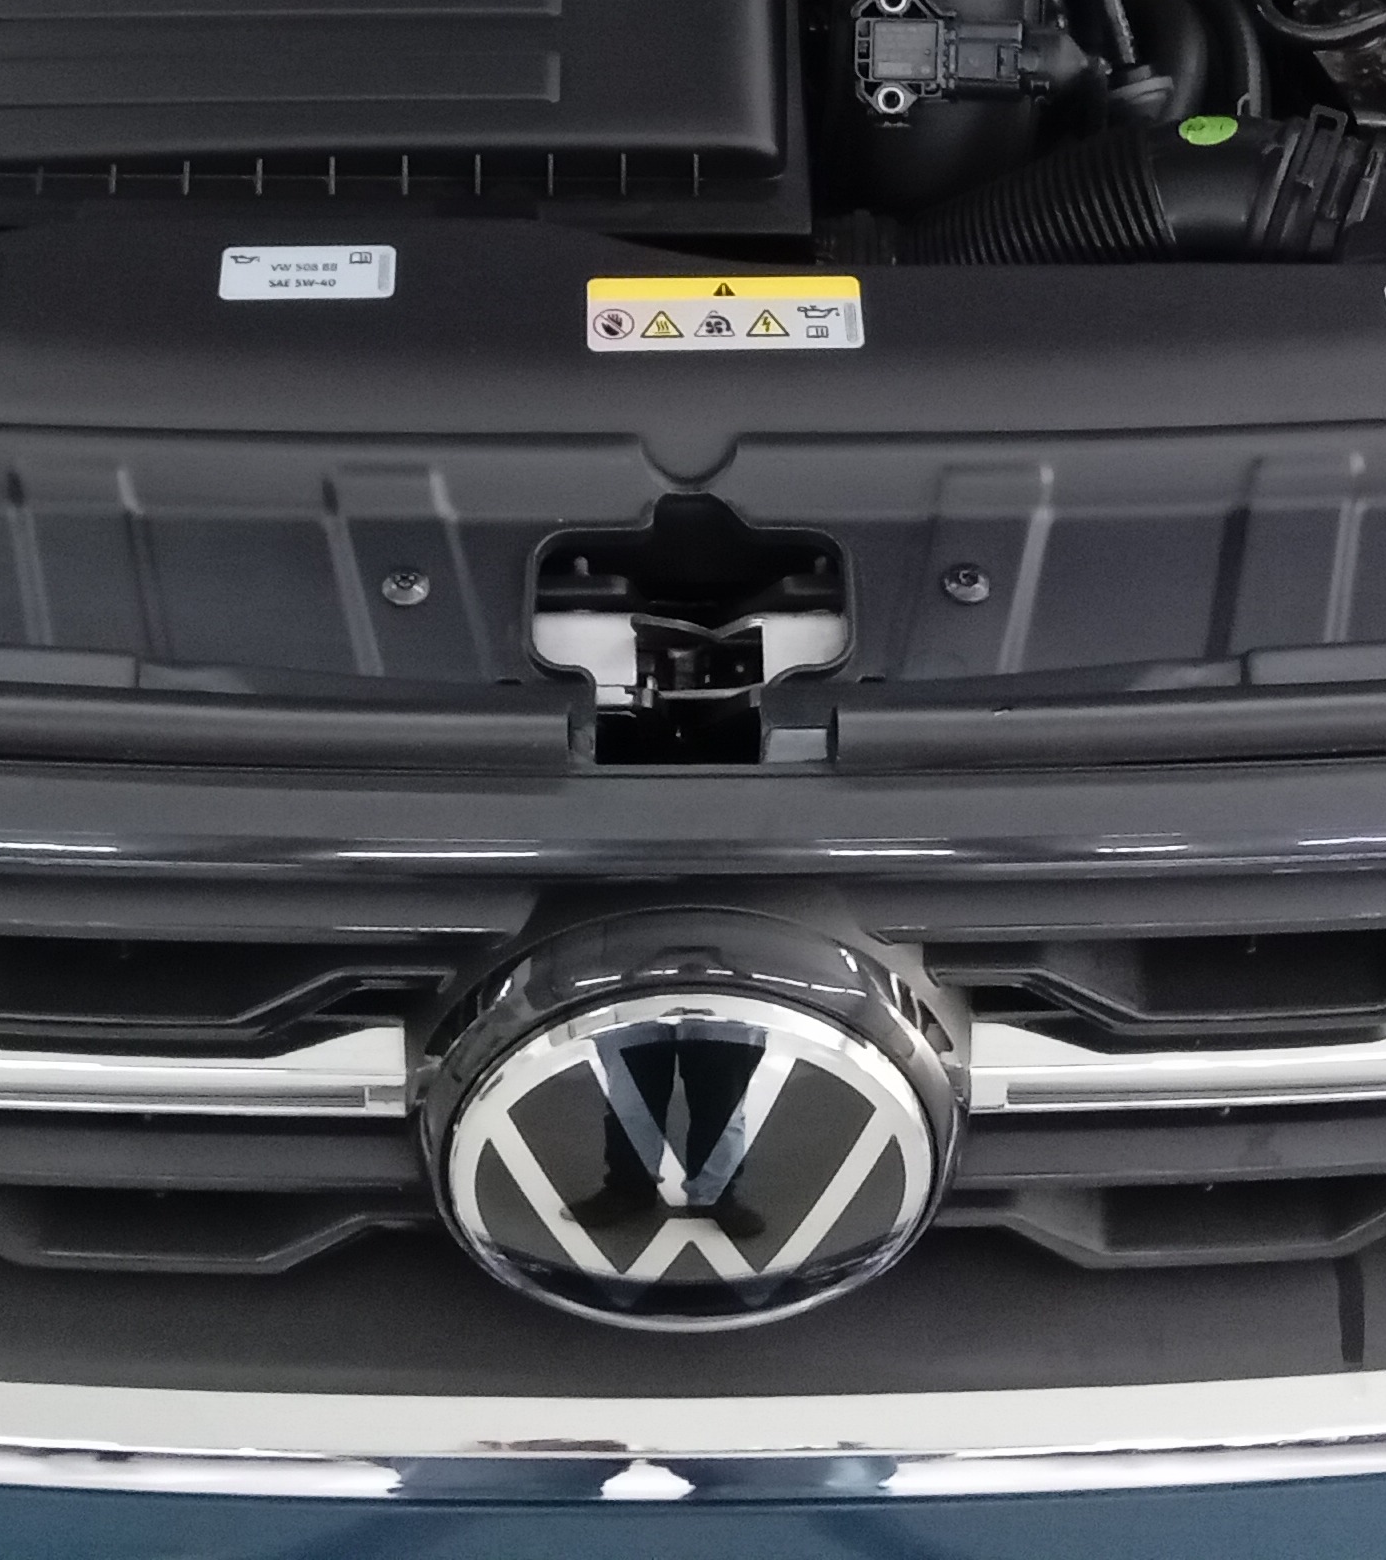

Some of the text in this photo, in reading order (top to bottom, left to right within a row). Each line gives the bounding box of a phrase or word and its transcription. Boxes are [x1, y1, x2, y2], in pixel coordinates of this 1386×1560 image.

[270, 263, 292, 272] VW
[268, 278, 337, 288] SAE 5W-40
